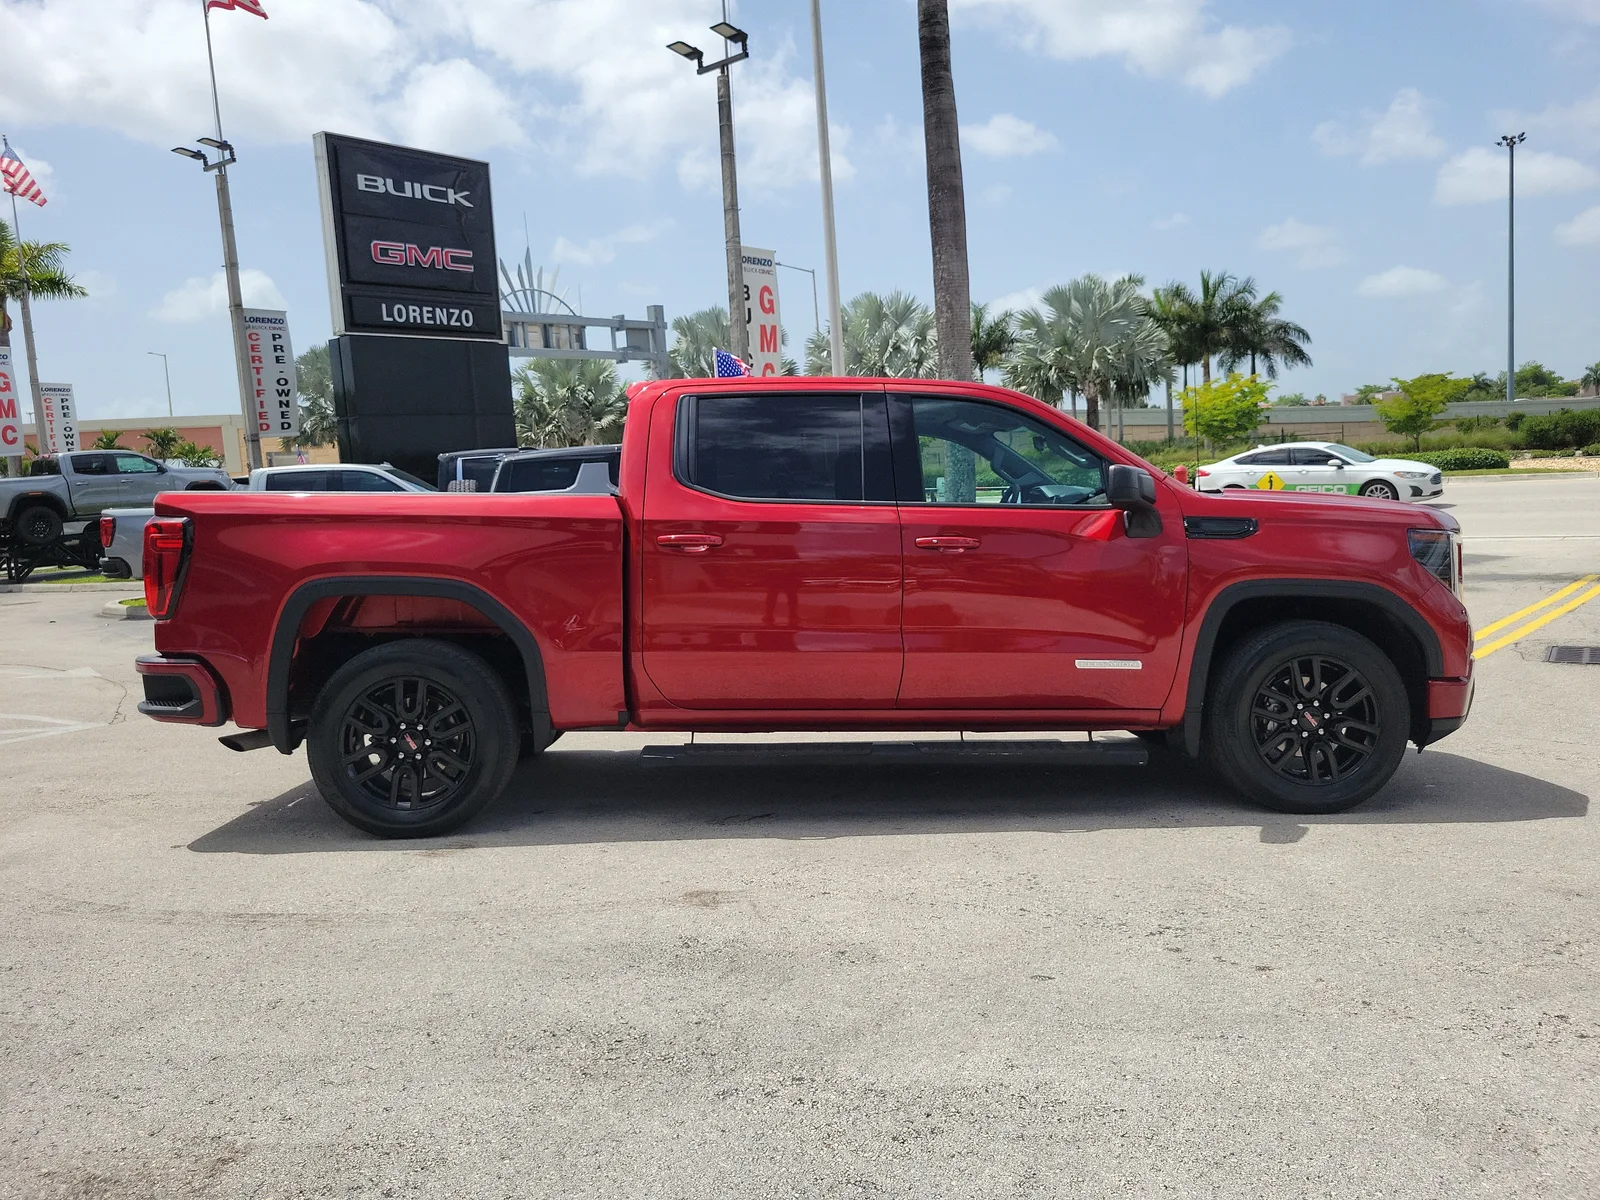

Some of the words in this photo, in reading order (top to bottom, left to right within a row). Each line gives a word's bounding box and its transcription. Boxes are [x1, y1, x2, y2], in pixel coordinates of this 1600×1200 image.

[356, 173, 475, 208] BUICK
[370, 240, 475, 273] GMC
[741, 255, 773, 267] ORENZO
[244, 316, 285, 325] LORENZO
[381, 303, 474, 327] LORENZO
[247, 332, 271, 431] CERTIFIED
[271, 333, 292, 430] PRE-OWNED
[0, 372, 18, 445] GMC
[43, 397, 58, 453] CERTIFIE
[60, 397, 75, 452] PRE-OWNE
[1296, 484, 1348, 495] GEICO
